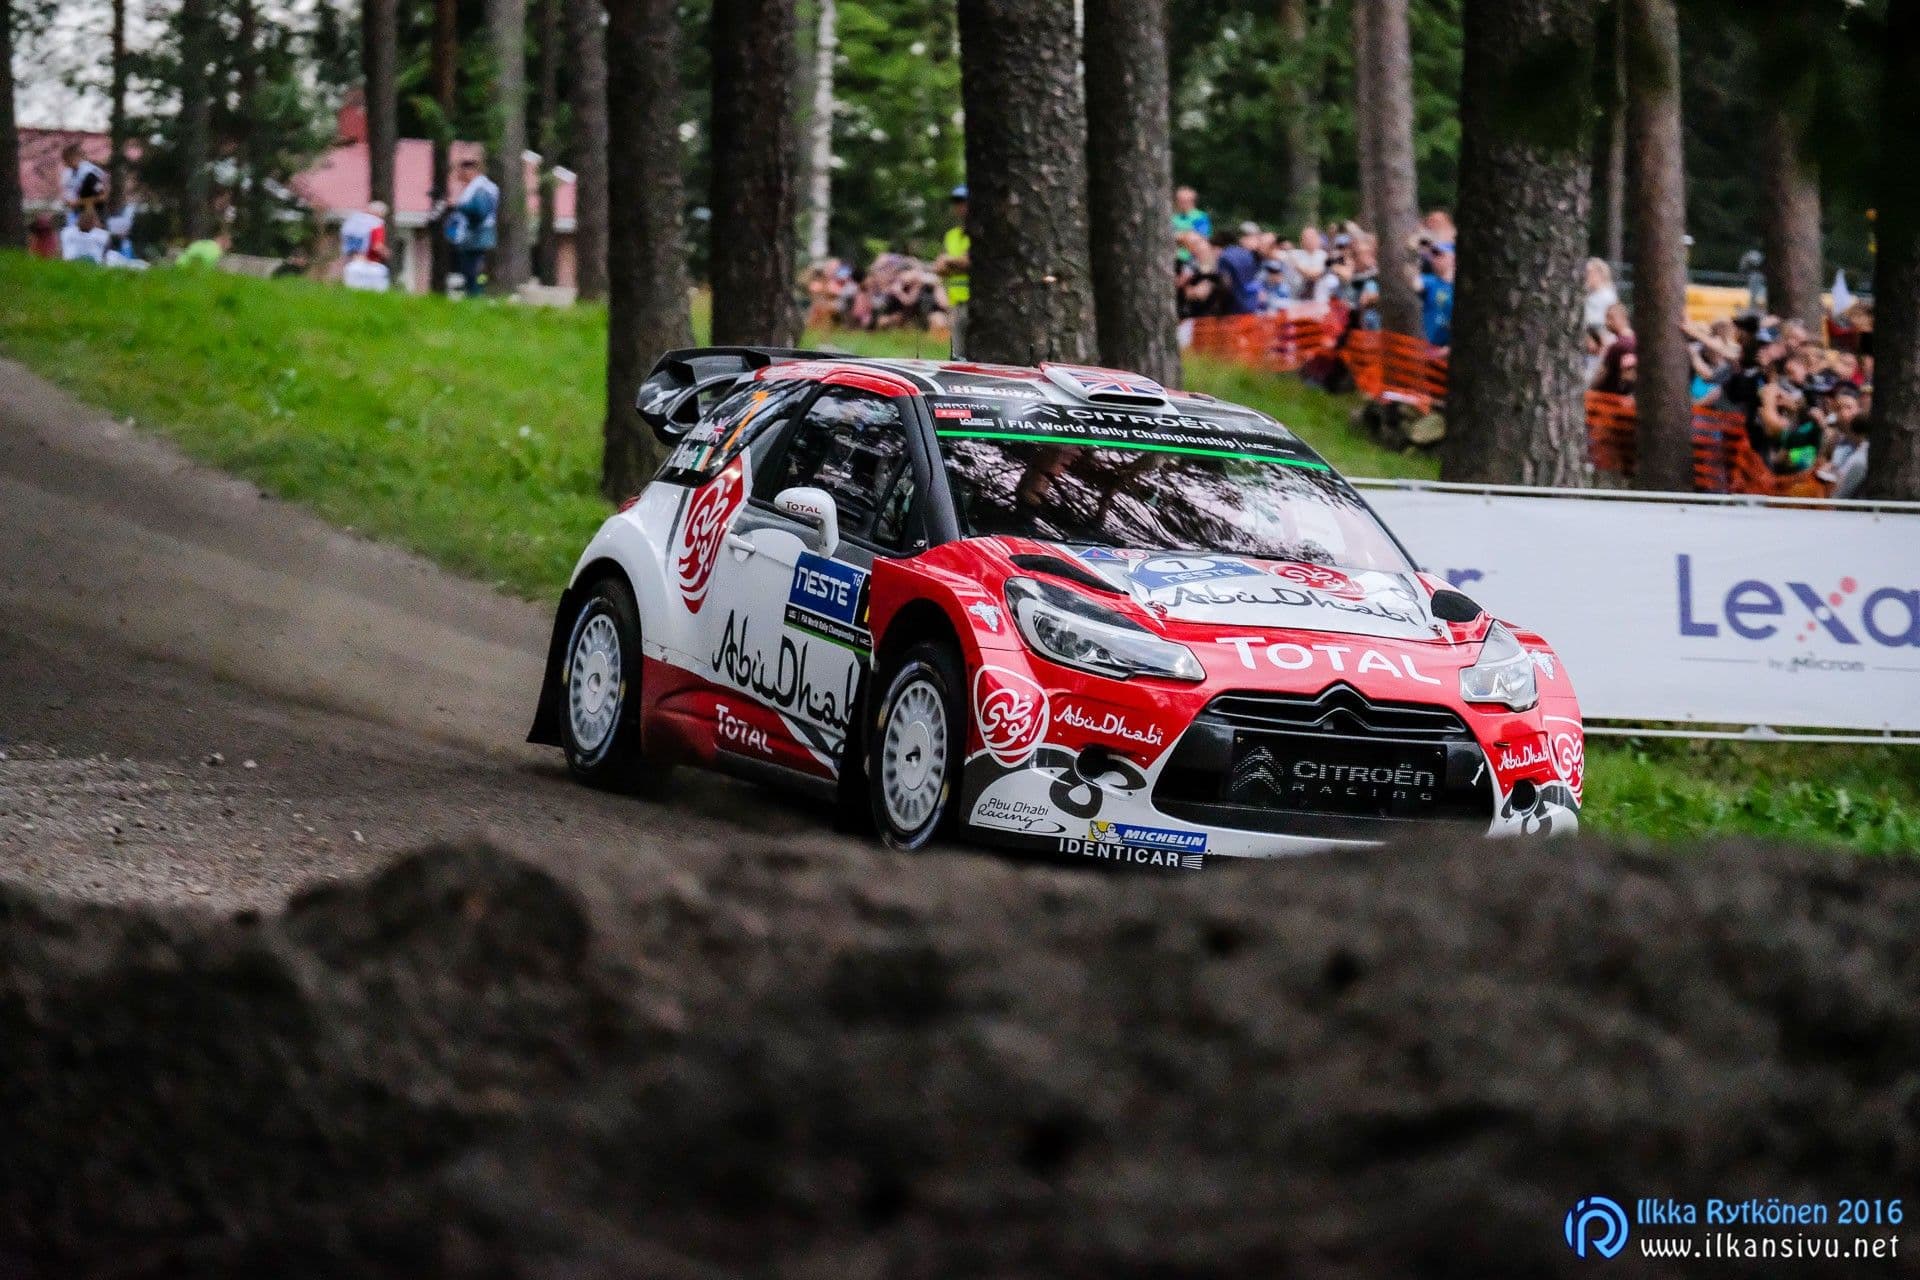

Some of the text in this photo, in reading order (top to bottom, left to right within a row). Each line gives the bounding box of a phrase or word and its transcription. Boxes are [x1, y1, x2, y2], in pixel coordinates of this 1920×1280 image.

[1008, 420, 1036, 430] FIA
[1037, 421, 1085, 434] World
[1090, 426, 1129, 439] Rally
[1131, 429, 1236, 450] Championship
[786, 501, 822, 515] TOTAL
[796, 566, 851, 606] NESTE
[1678, 553, 1920, 649] Lexa
[1216, 636, 1442, 686] TOTAL
[775, 634, 855, 729] Dhab
[715, 703, 773, 754] TOTAL
[977, 803, 1044, 827] Racing
[987, 797, 1049, 816] Abu Dhabi
[1058, 838, 1180, 868] IDENTICAR
[1123, 829, 1205, 847] MICHELIN
